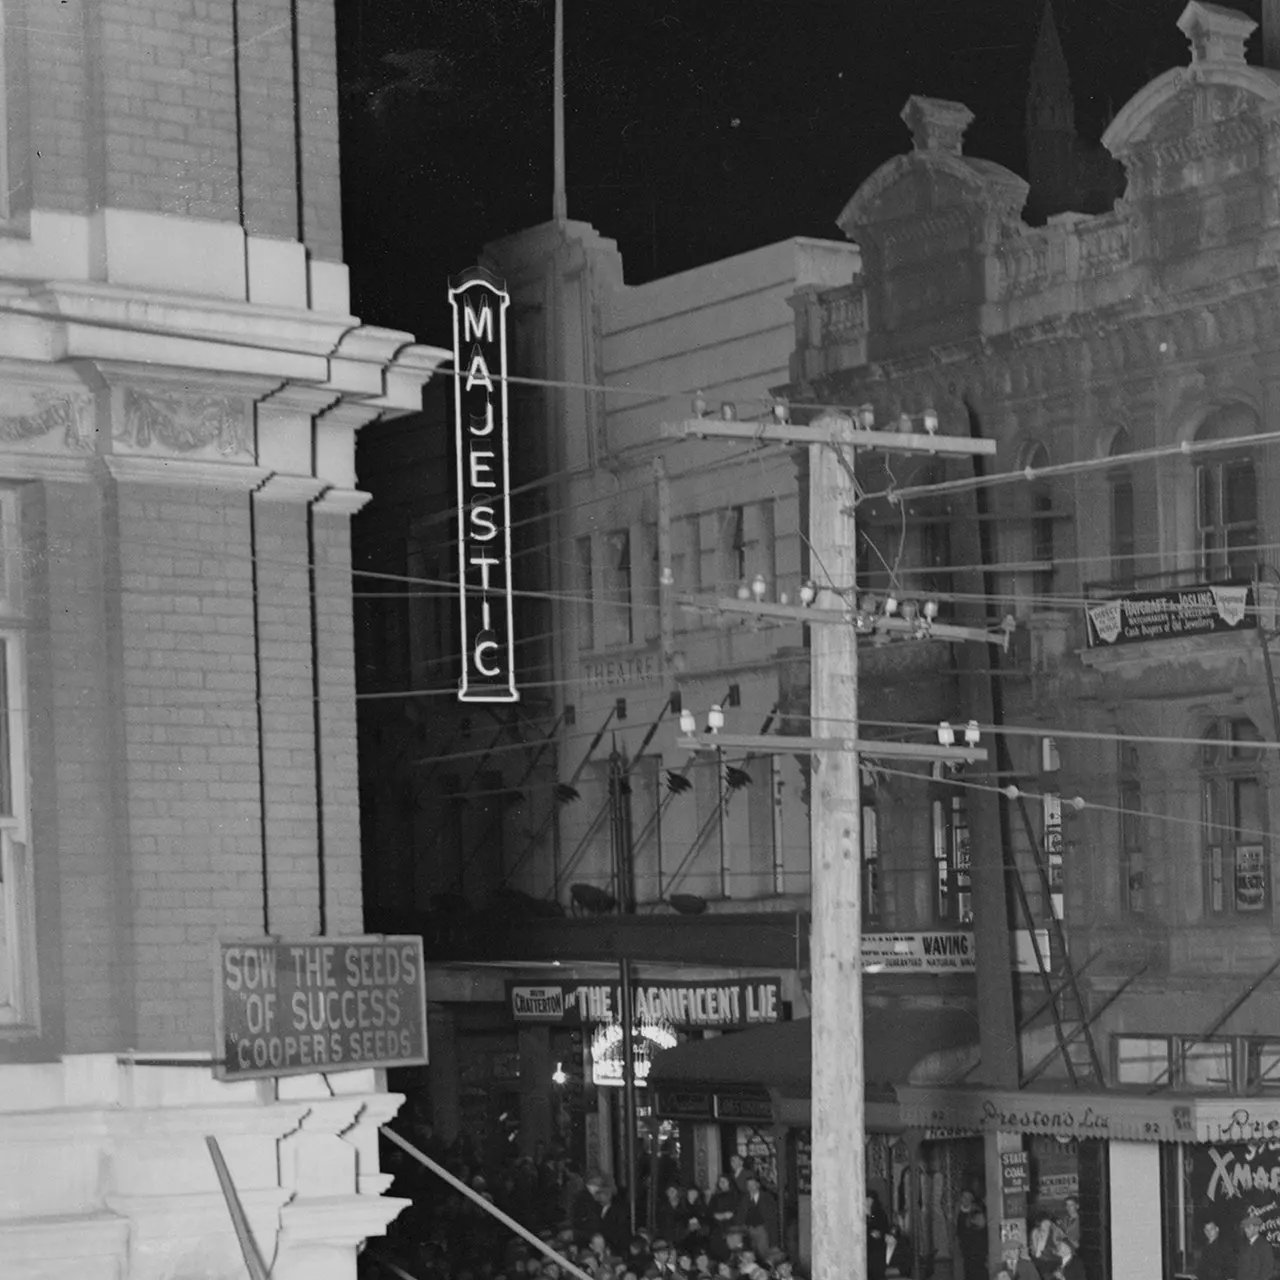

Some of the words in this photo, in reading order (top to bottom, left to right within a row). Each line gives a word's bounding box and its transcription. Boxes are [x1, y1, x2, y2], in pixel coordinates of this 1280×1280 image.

[464, 293, 499, 677] MAJESTIC
[585, 655, 653, 687] THEATRE
[923, 936, 968, 955] WAVING
[225, 948, 276, 990] SOW
[291, 946, 336, 987] THE
[291, 989, 401, 1030] SUCCESS
[577, 986, 611, 1021] THE
[746, 985, 777, 1023] LIE
